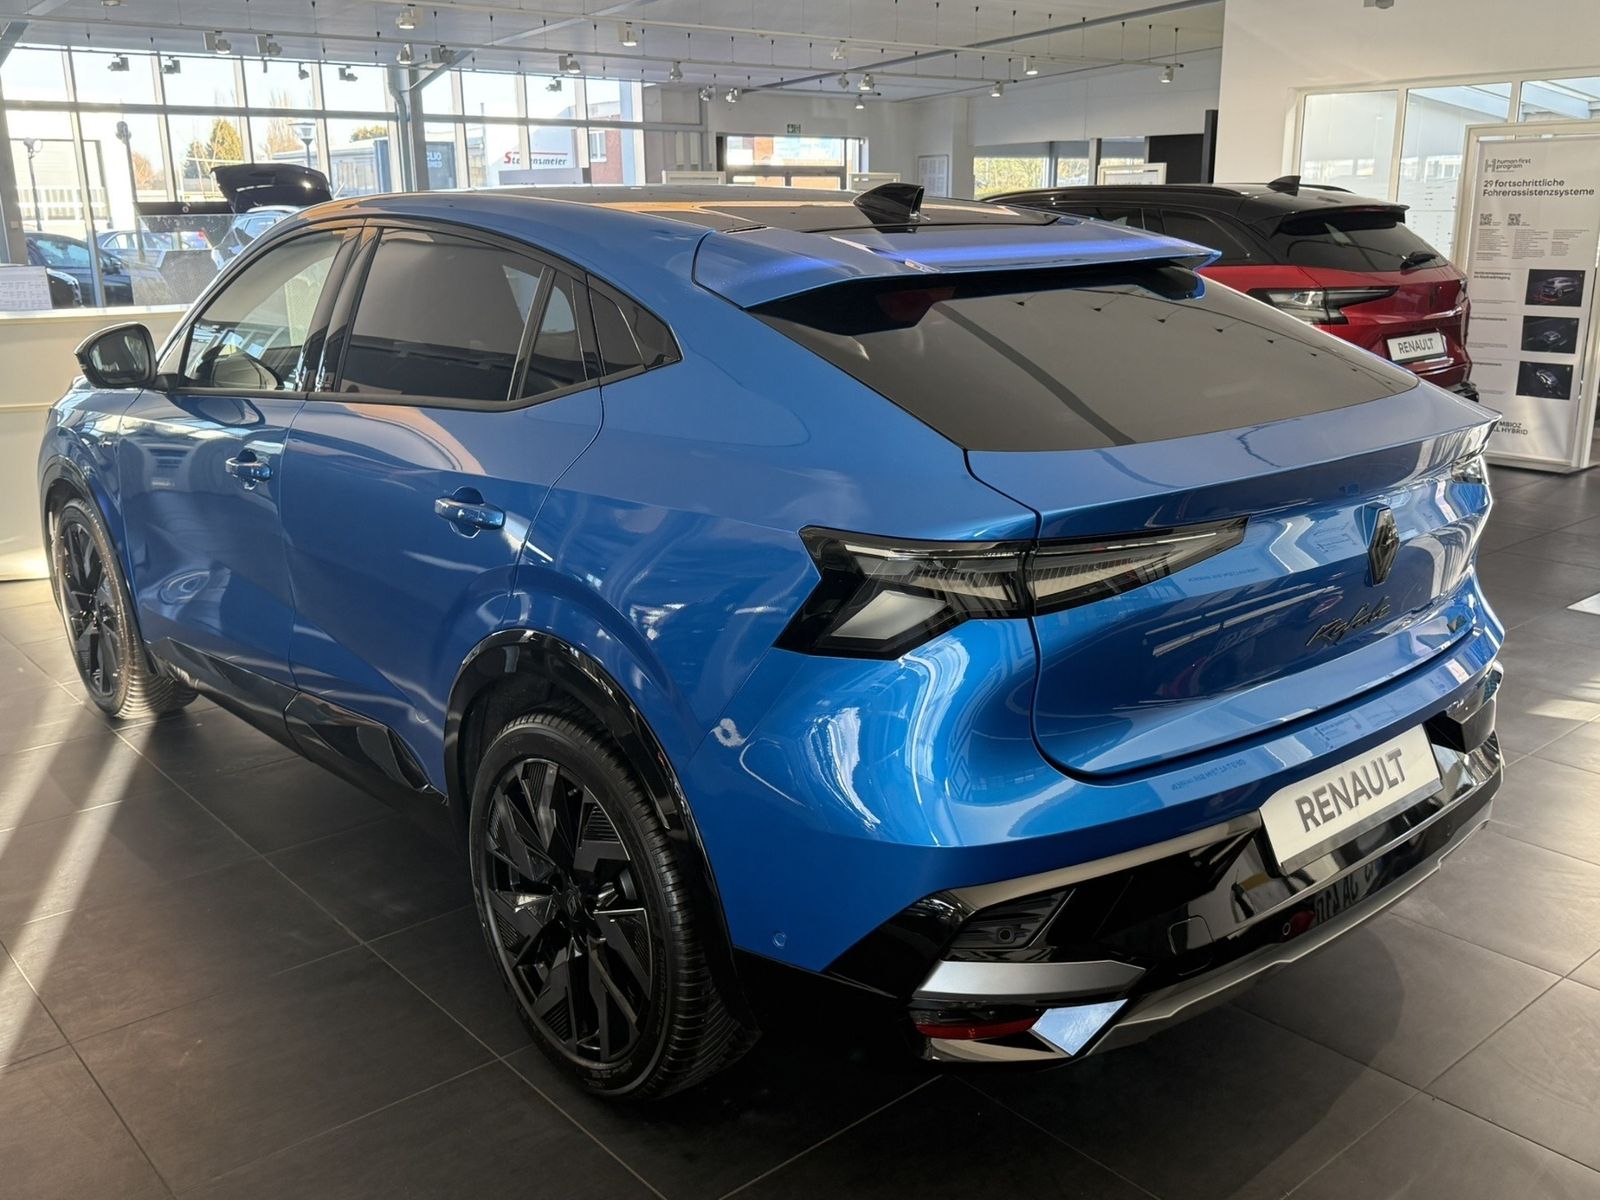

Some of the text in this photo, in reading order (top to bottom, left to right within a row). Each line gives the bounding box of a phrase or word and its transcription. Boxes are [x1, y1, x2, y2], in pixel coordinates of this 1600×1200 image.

[1483, 179, 1565, 188] 29 fortschrittliche
[1482, 188, 1595, 198] Fahrerassistenzsysteme
[1397, 338, 1435, 354] RENAULT
[1295, 750, 1406, 832] RENAULT
